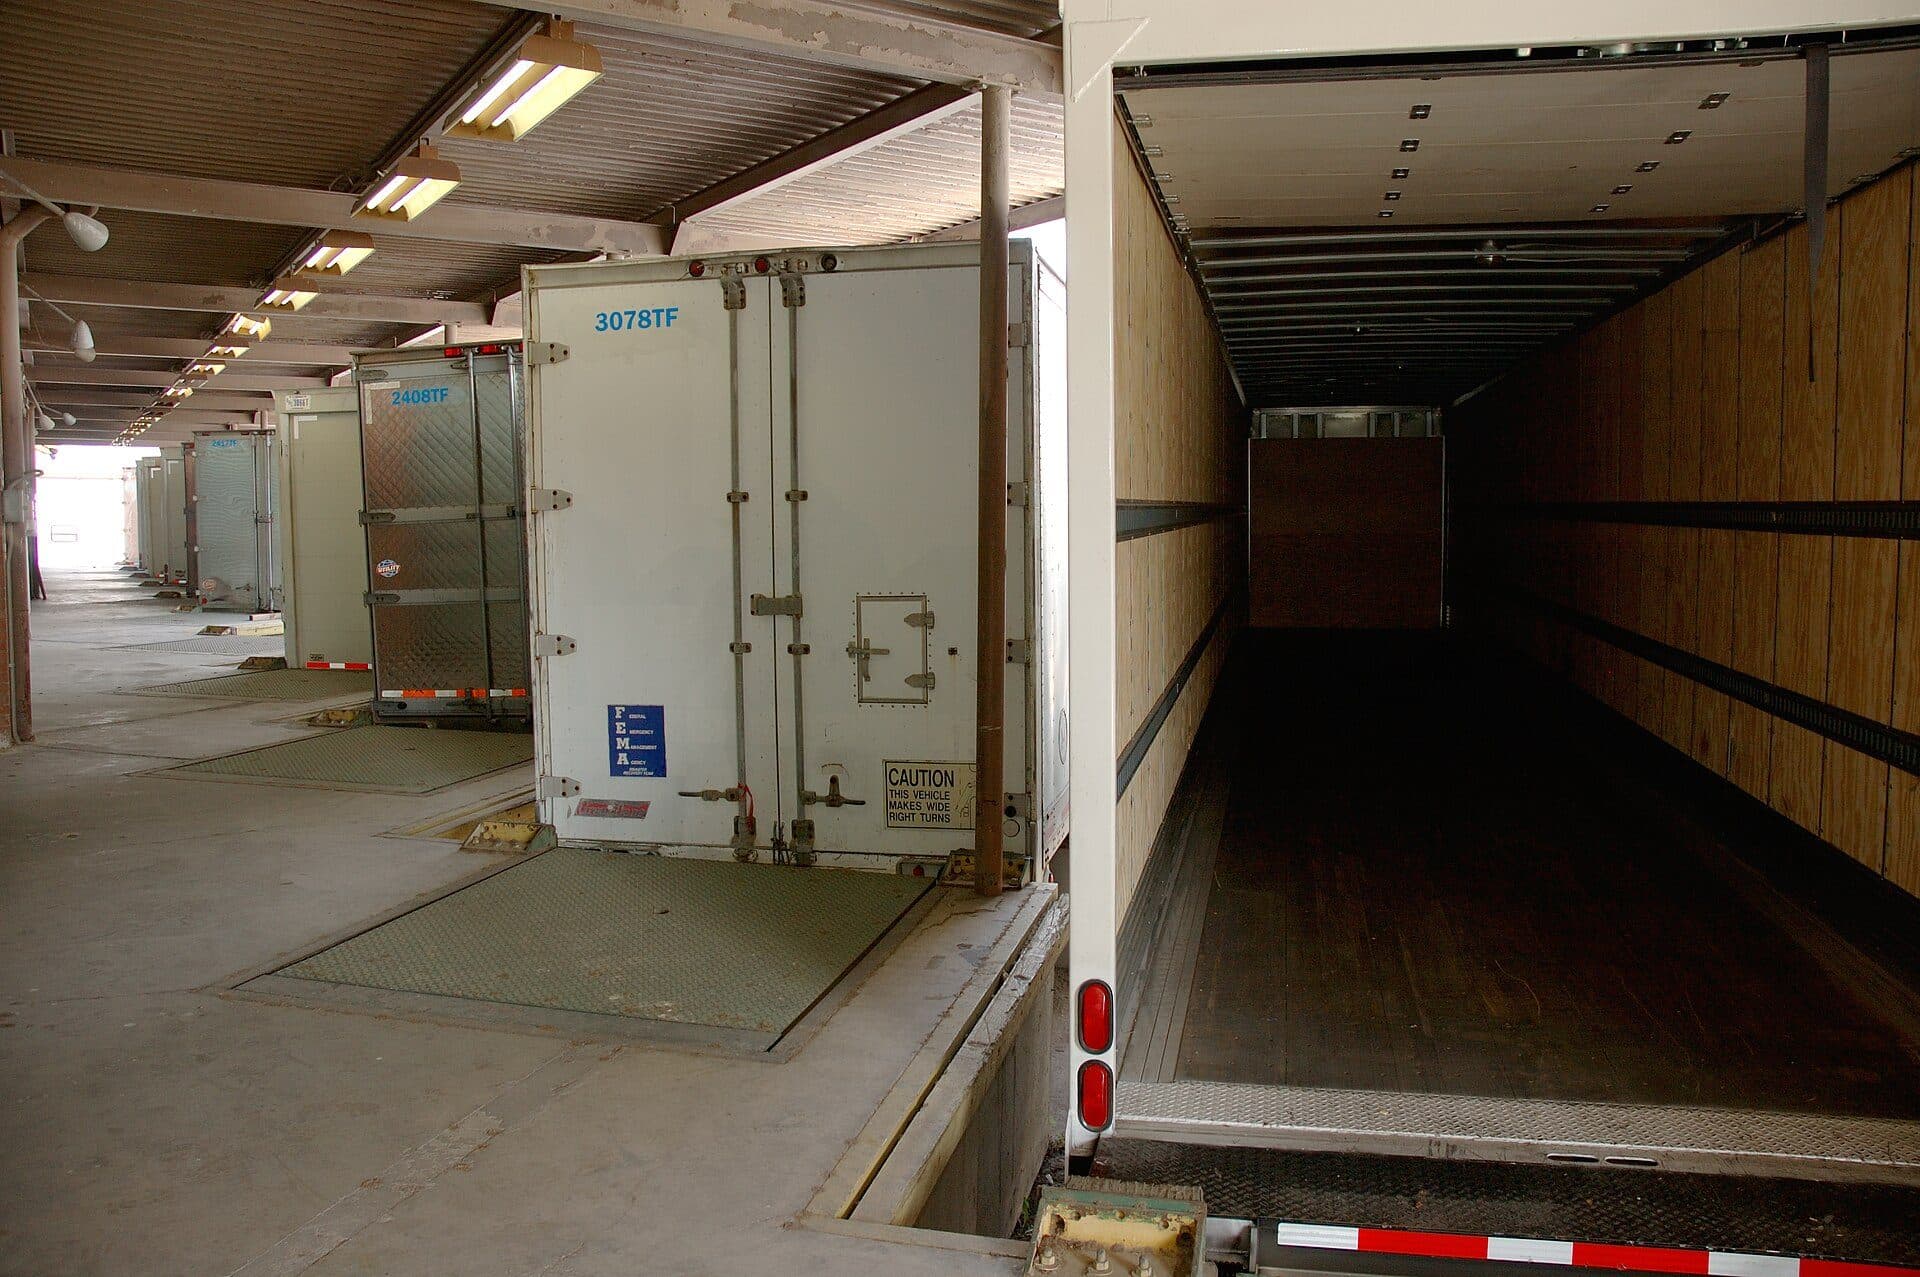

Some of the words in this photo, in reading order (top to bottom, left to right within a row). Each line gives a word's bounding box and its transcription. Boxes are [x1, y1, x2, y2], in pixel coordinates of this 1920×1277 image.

[594, 307, 679, 332] 3078TF
[391, 387, 449, 405] 2408TF
[888, 768, 954, 787] CAUTION
[888, 789, 910, 799] THIS
[912, 790, 951, 801] VEHICLE
[888, 801, 922, 811] MAKES
[926, 802, 951, 812] WIDE
[889, 812, 916, 822] RIGHT
[920, 813, 951, 823] TURNS
